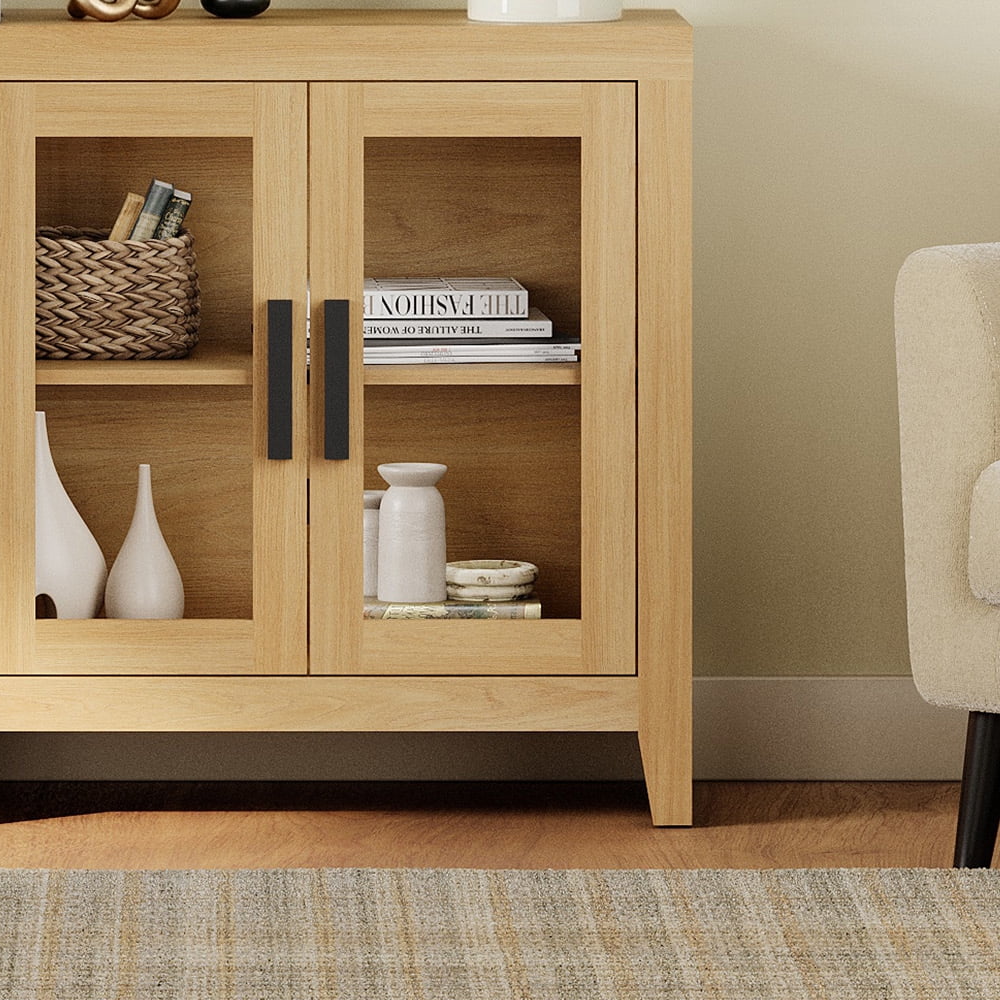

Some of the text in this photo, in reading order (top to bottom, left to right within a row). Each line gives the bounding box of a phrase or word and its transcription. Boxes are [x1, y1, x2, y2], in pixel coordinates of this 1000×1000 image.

[380, 294, 475, 316] FASHION
[480, 294, 526, 316] THE
[400, 325, 416, 335] OF
[417, 325, 459, 335] ALLURE
[461, 325, 483, 335] THE
